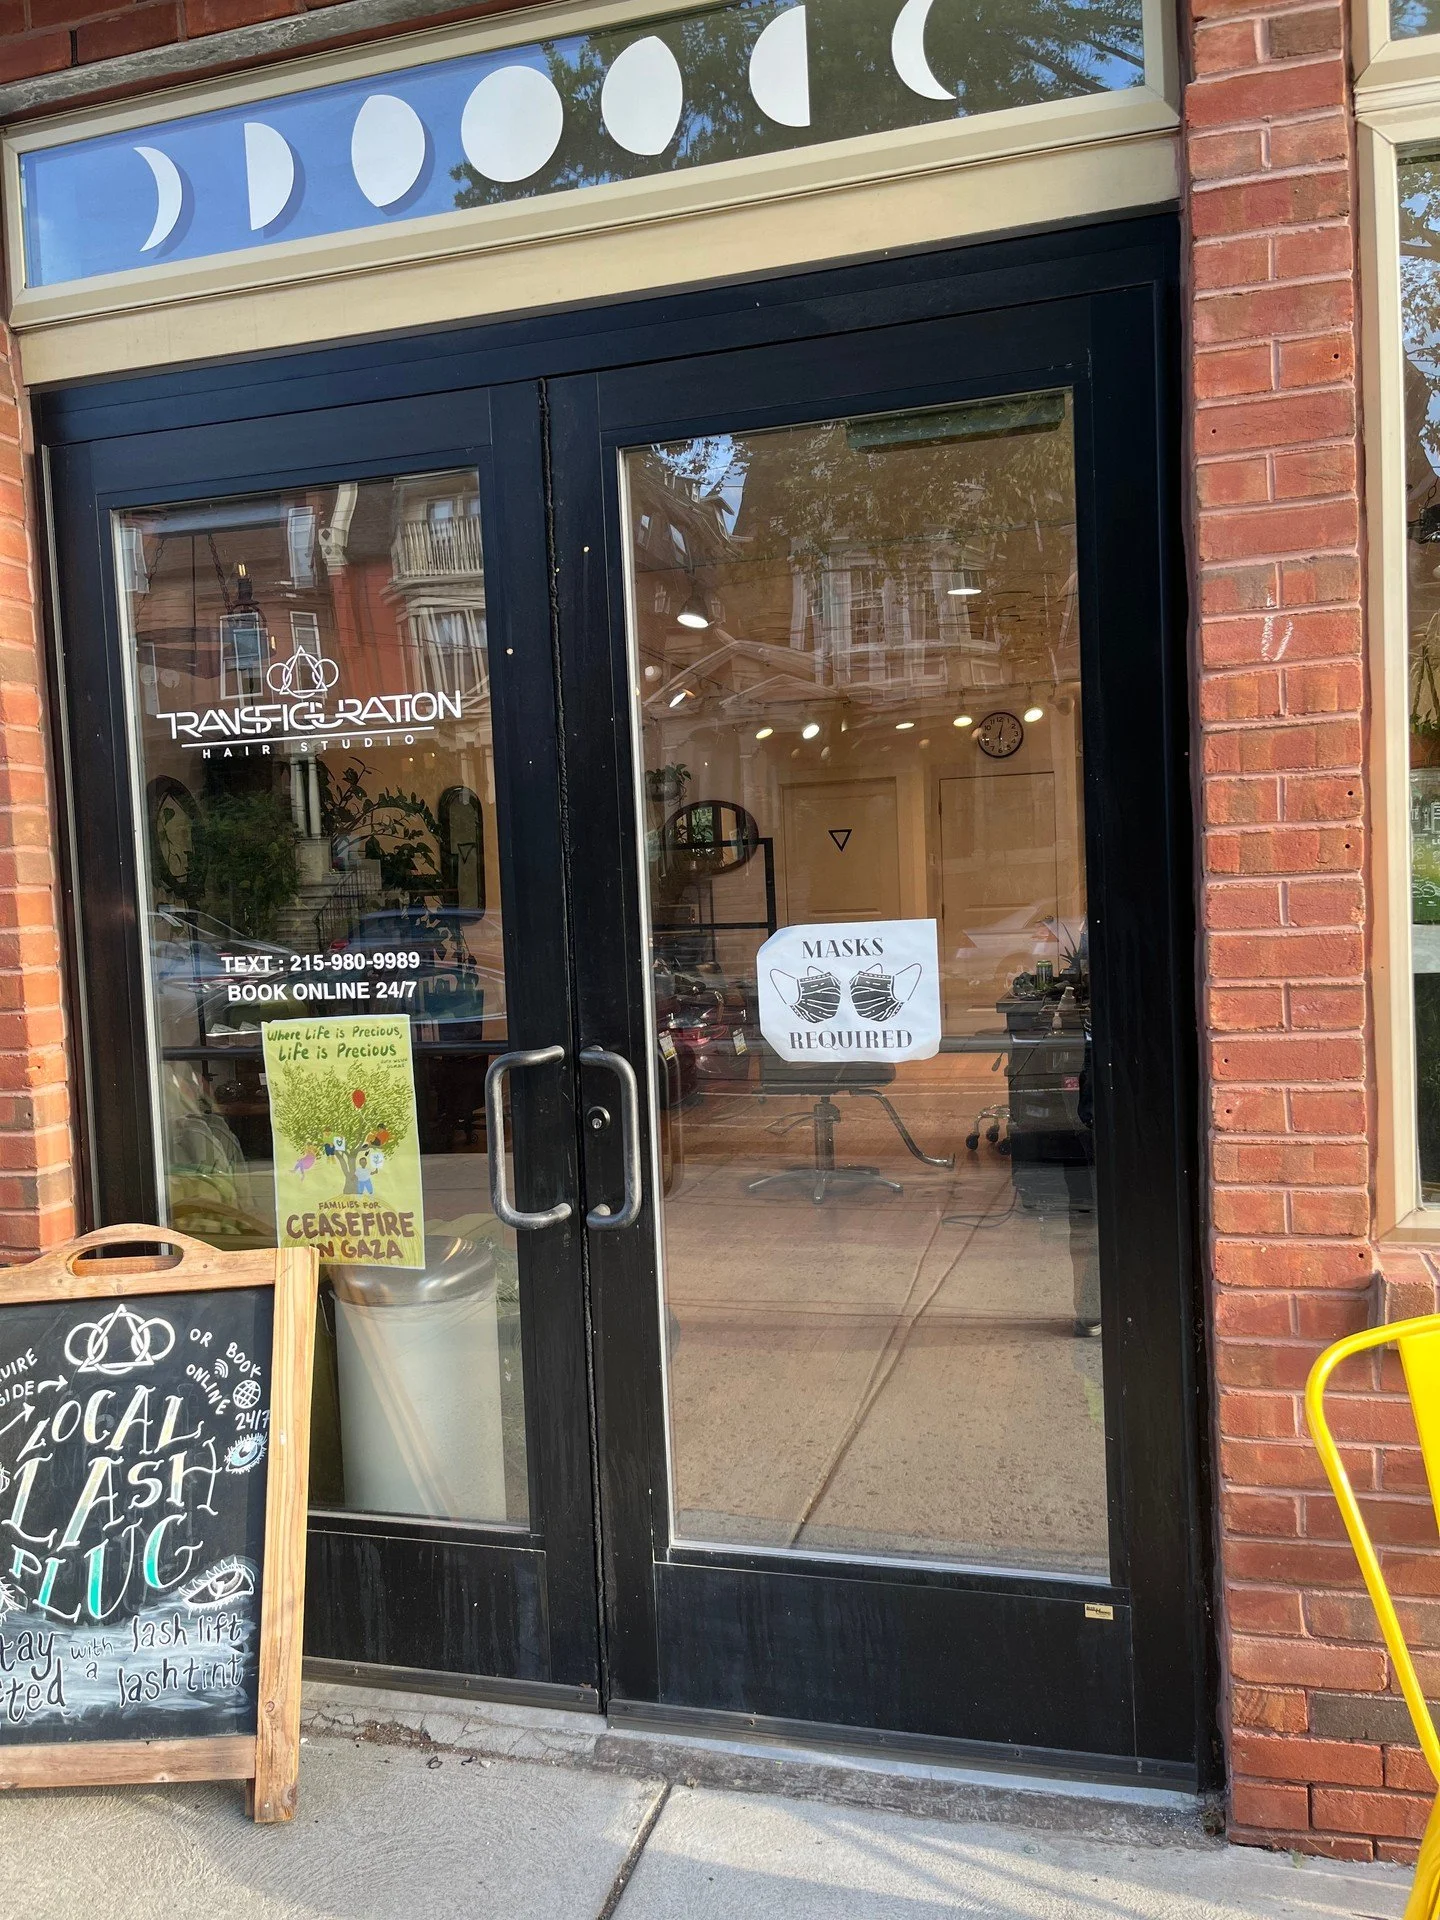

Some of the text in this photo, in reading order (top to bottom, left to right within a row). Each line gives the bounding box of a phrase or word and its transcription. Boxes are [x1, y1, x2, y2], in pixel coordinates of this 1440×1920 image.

[156, 690, 462, 740] TRANSFIGURATION
[202, 734, 415, 759] HAIR STUDIO
[801, 937, 884, 959] MASKS
[221, 955, 273, 973] TEXT
[289, 951, 420, 972] 215-980-9989
[227, 981, 417, 1002] BOOK ONLINE 24/7
[267, 1025, 403, 1041] Where Life is Precious,
[788, 1029, 912, 1051] REQUIRED
[278, 1041, 397, 1061] Life is Precious
[318, 1200, 381, 1210] FAMILIES FOR
[286, 1211, 415, 1239] CEASEFIRE
[310, 1239, 404, 1260] N GAZA
[0, 1347, 38, 1380] UIRE
[189, 1328, 261, 1378] OR BOOK
[186, 1364, 231, 1414] ONLINE
[16, 1384, 205, 1461] LOCAL
[235, 1409, 271, 1431] 24/7
[1, 1437, 222, 1552] LASH
[9, 1512, 204, 1623] PLUG
[131, 1612, 244, 1653] lash lift
[70, 1637, 114, 1660] with
[85, 1661, 98, 1681] a
[0, 1656, 66, 1723] ted
